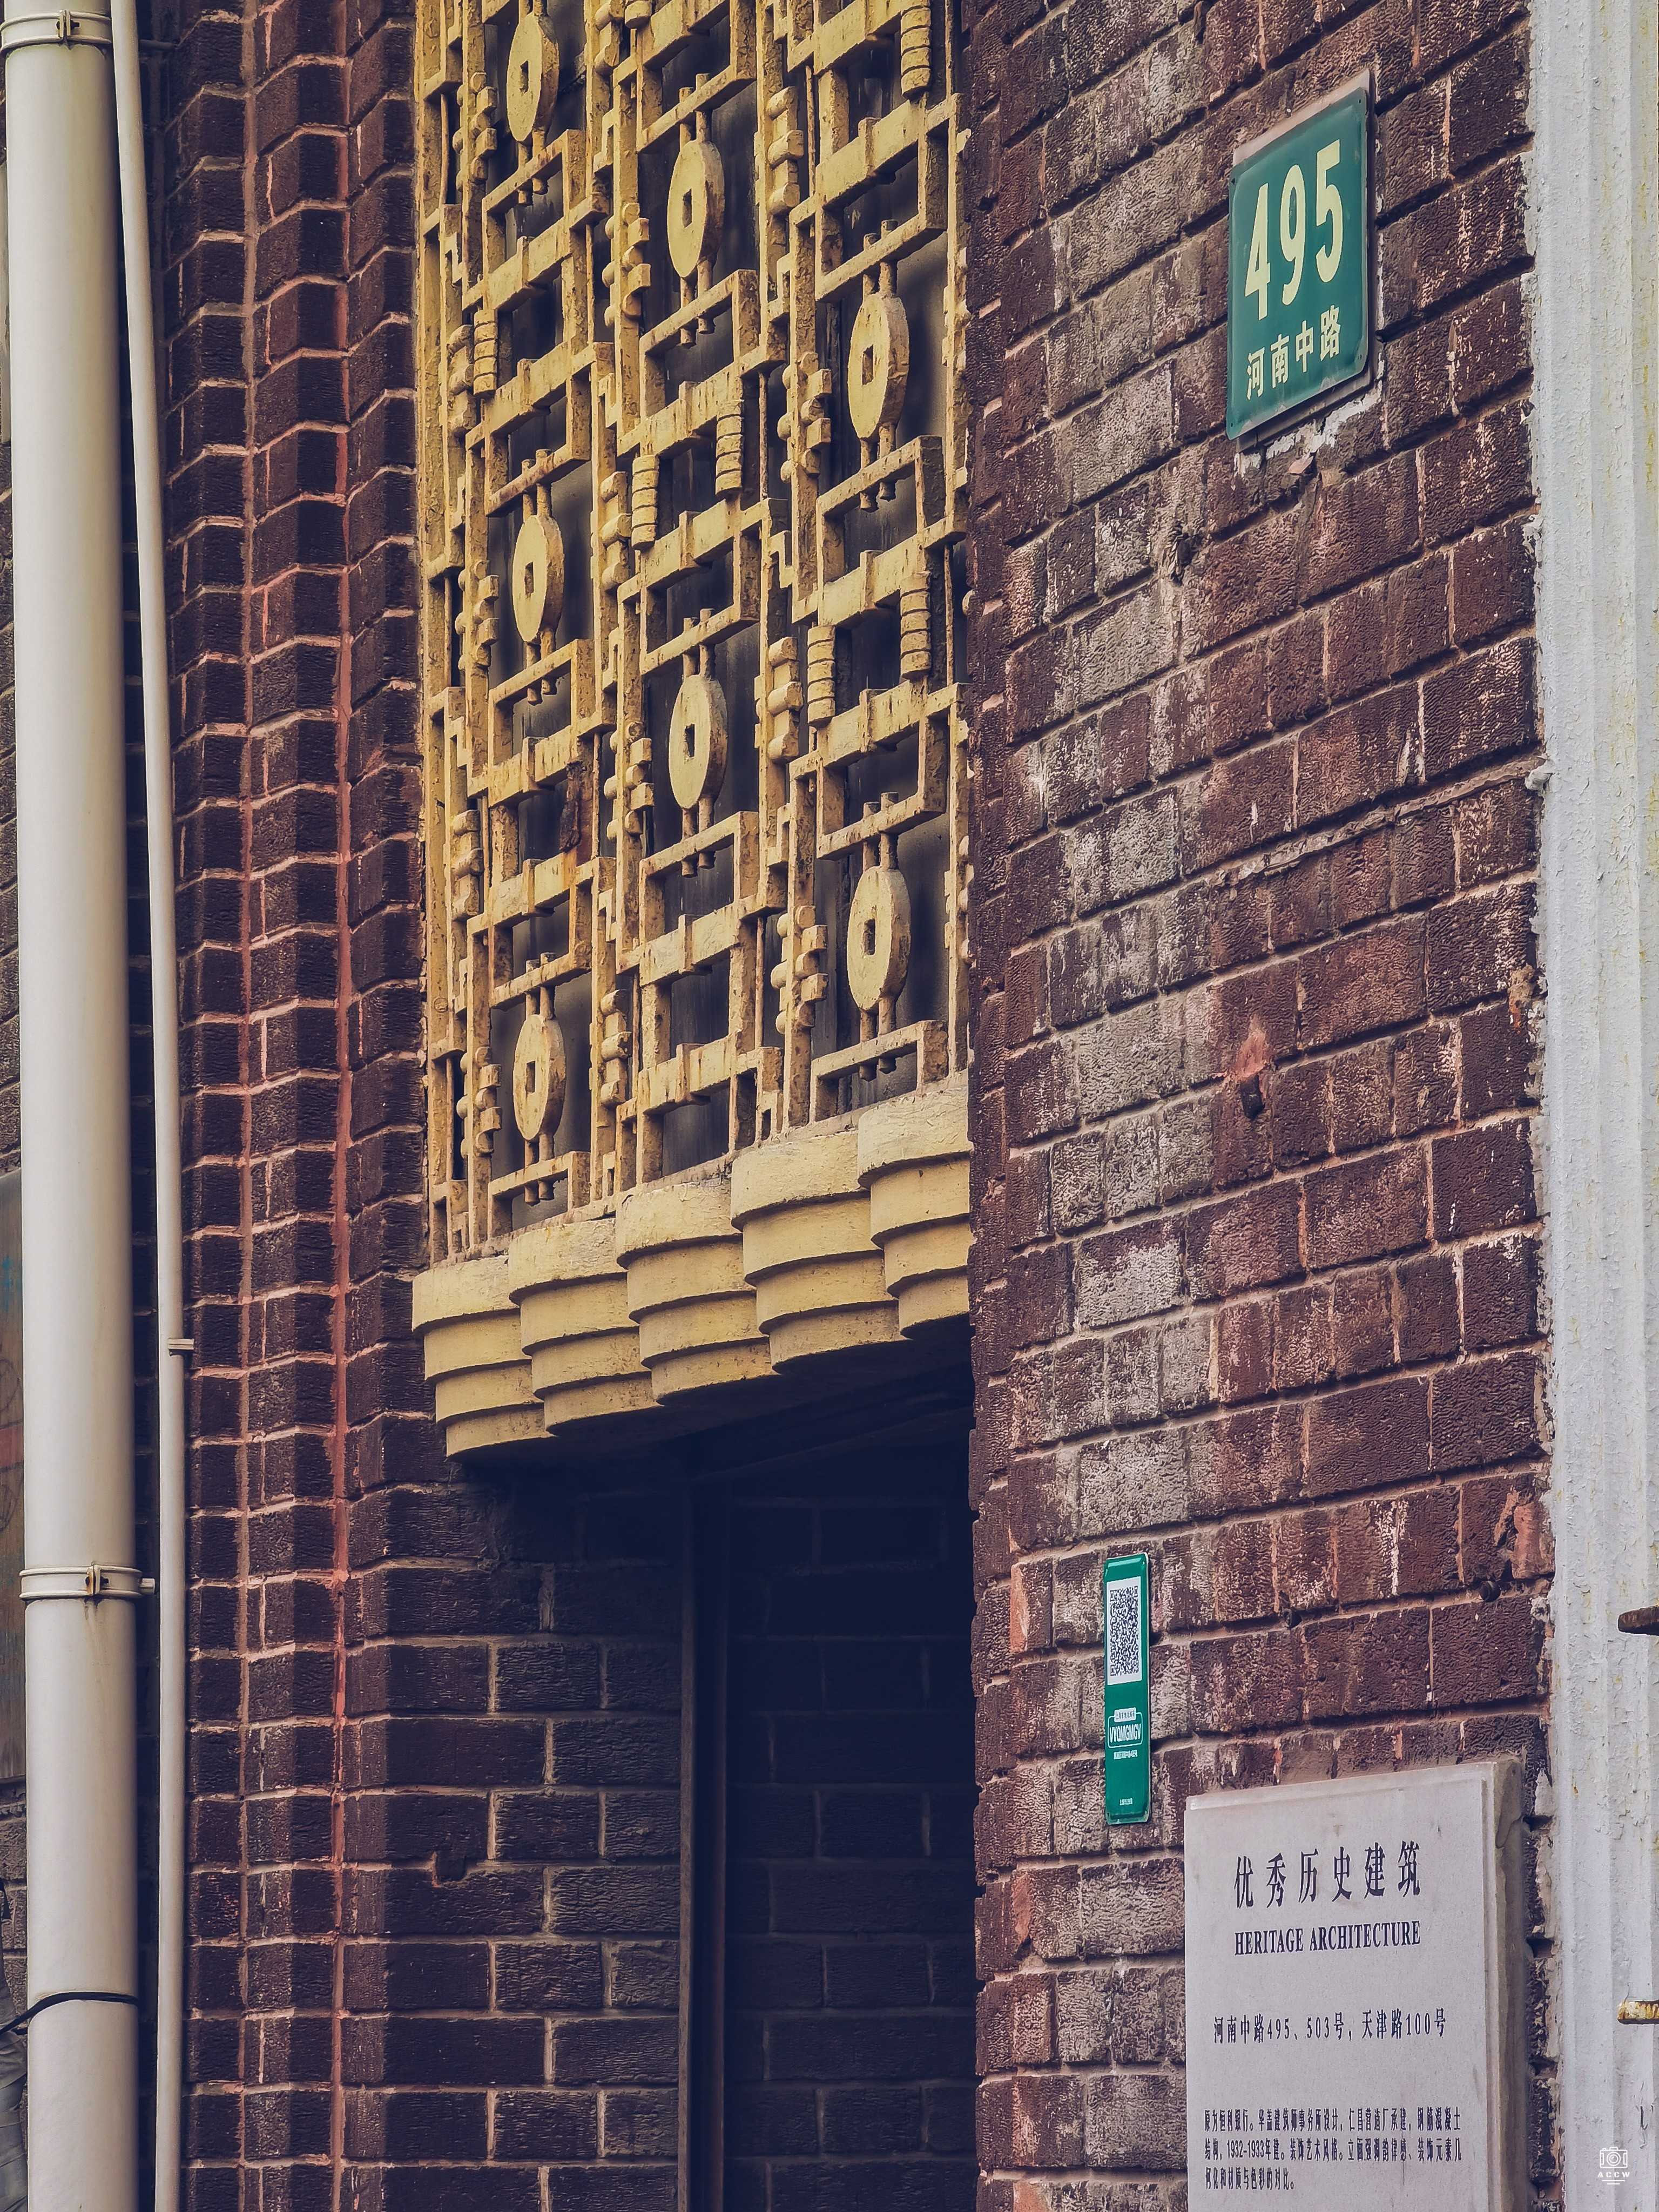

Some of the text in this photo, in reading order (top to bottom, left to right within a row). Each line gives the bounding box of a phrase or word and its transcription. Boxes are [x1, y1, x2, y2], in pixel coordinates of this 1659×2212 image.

[1245, 138, 1344, 321] 495
[1246, 305, 1341, 401] 河南中路
[1234, 1840, 1421, 1909] 优秀历史建筑
[1235, 1920, 1421, 1955] HERITAGE ARCHITECTURE
